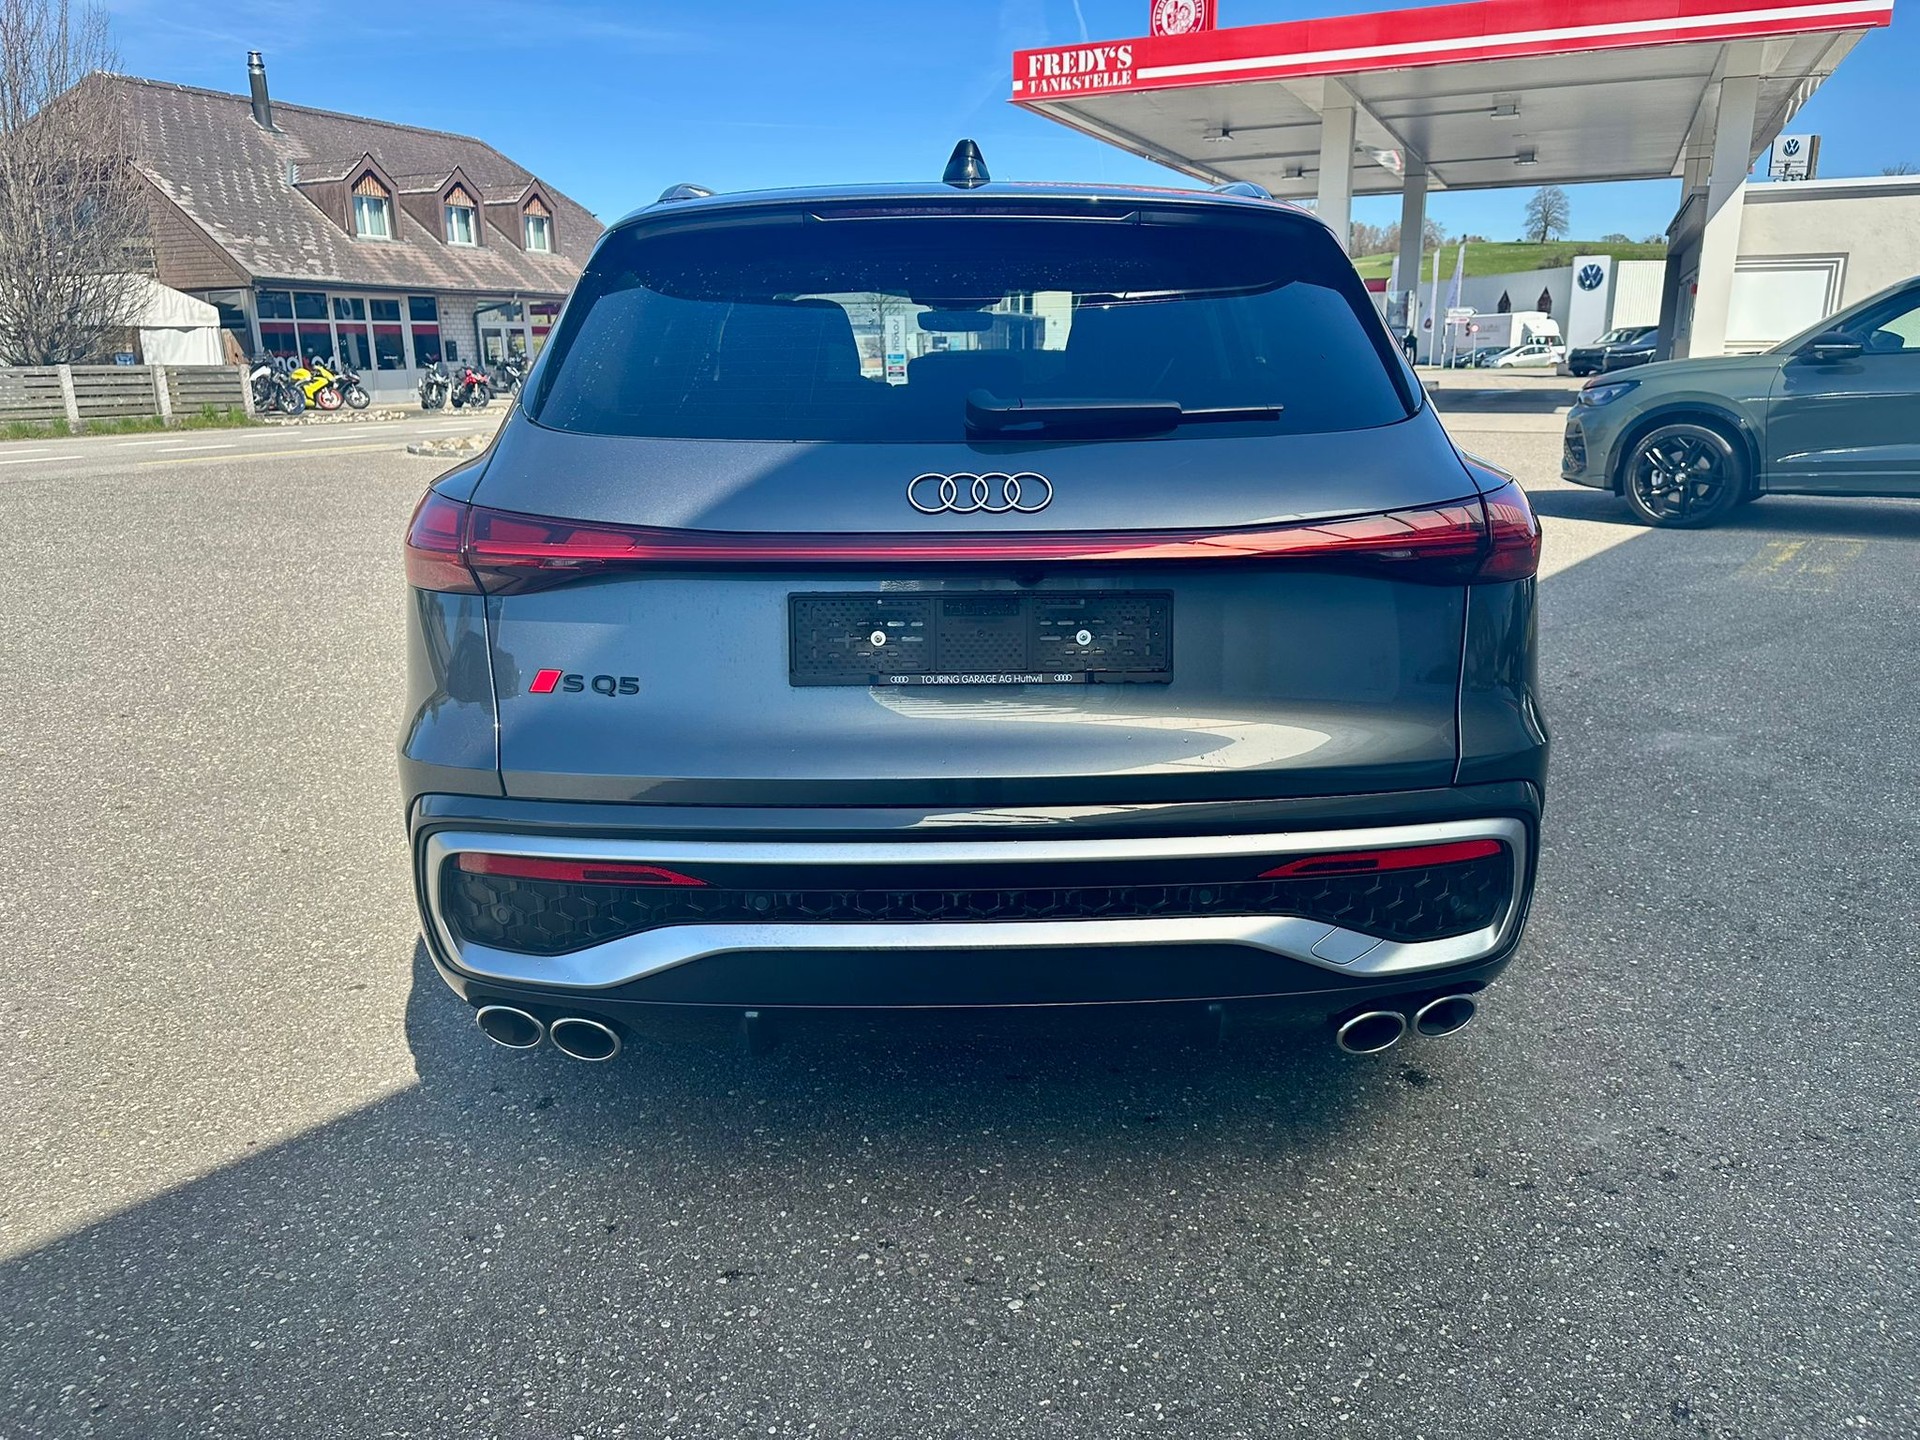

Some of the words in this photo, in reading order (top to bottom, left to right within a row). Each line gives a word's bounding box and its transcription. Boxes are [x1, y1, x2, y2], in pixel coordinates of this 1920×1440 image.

[1028, 44, 1133, 77] FREDY'S
[1028, 70, 1132, 94] TANKSTELLE
[920, 674, 960, 684] TOURING
[961, 674, 998, 684] GARAGE
[998, 674, 1012, 684] AG
[1013, 673, 1043, 684] Huttwil
